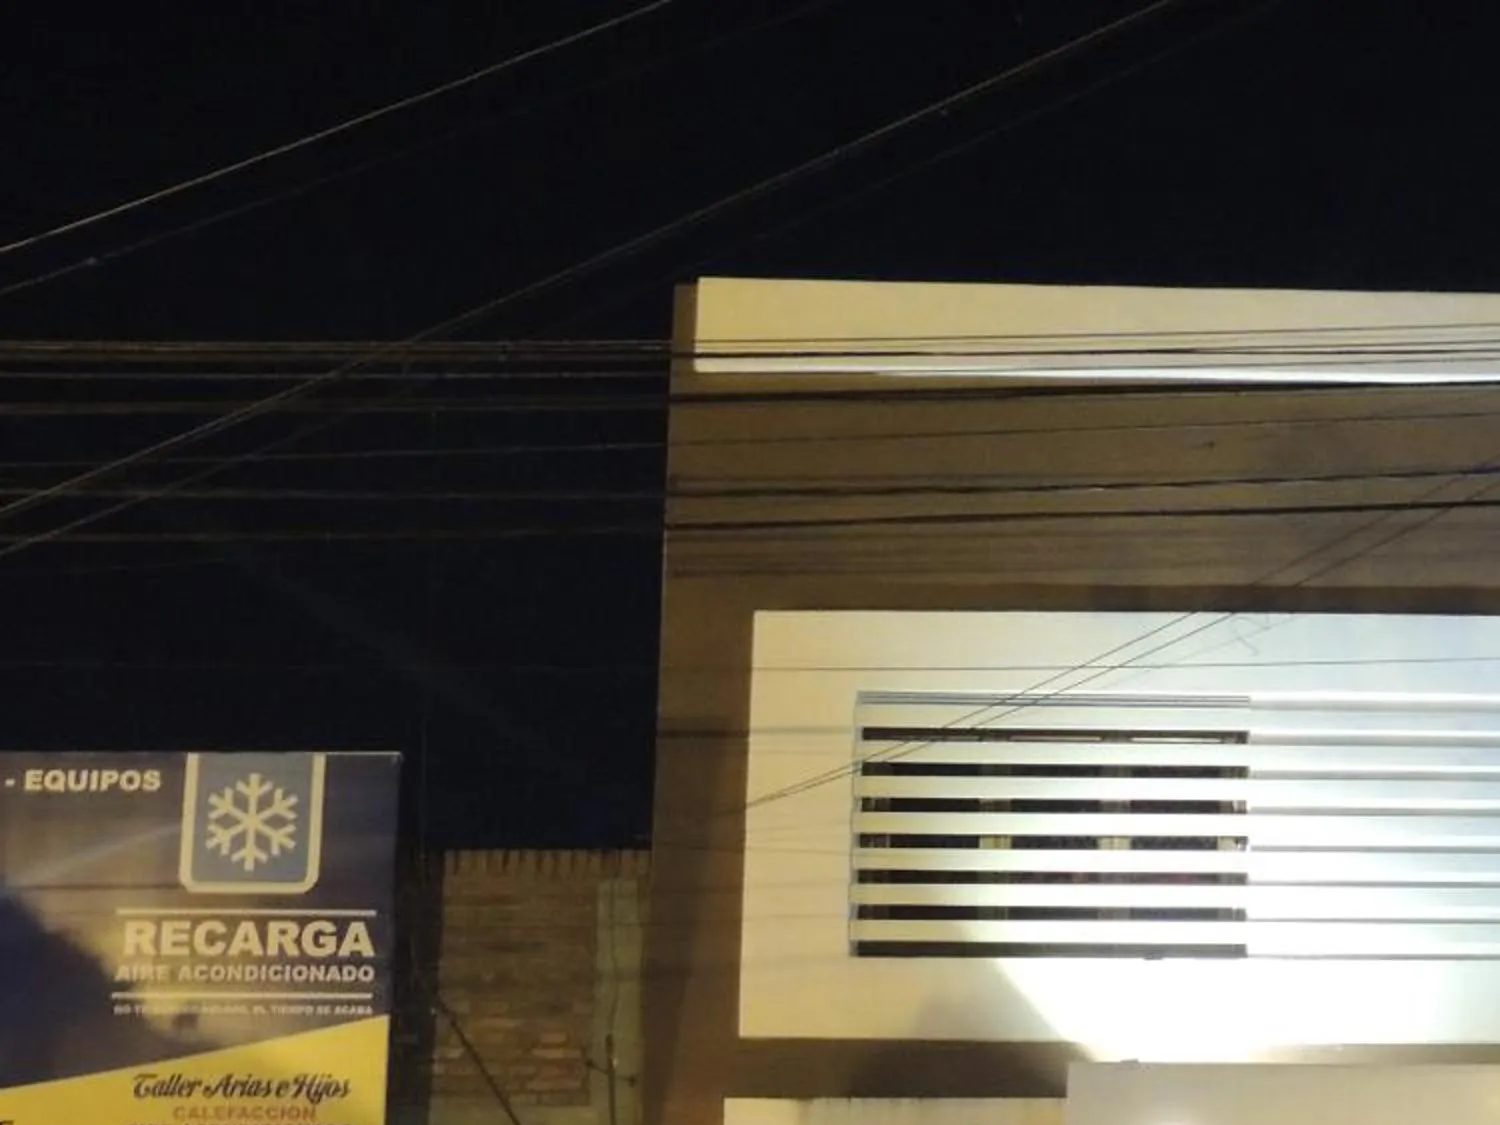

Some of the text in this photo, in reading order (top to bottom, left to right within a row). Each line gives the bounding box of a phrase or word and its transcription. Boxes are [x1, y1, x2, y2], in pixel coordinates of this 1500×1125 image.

[24, 768, 162, 793] EQUIPOS
[123, 919, 376, 958] RECARGA
[114, 964, 376, 983] AIRE ACONDICIONADO
[133, 1073, 202, 1099] Taller
[203, 1073, 271, 1099] Arias
[290, 1072, 351, 1105] Hijos
